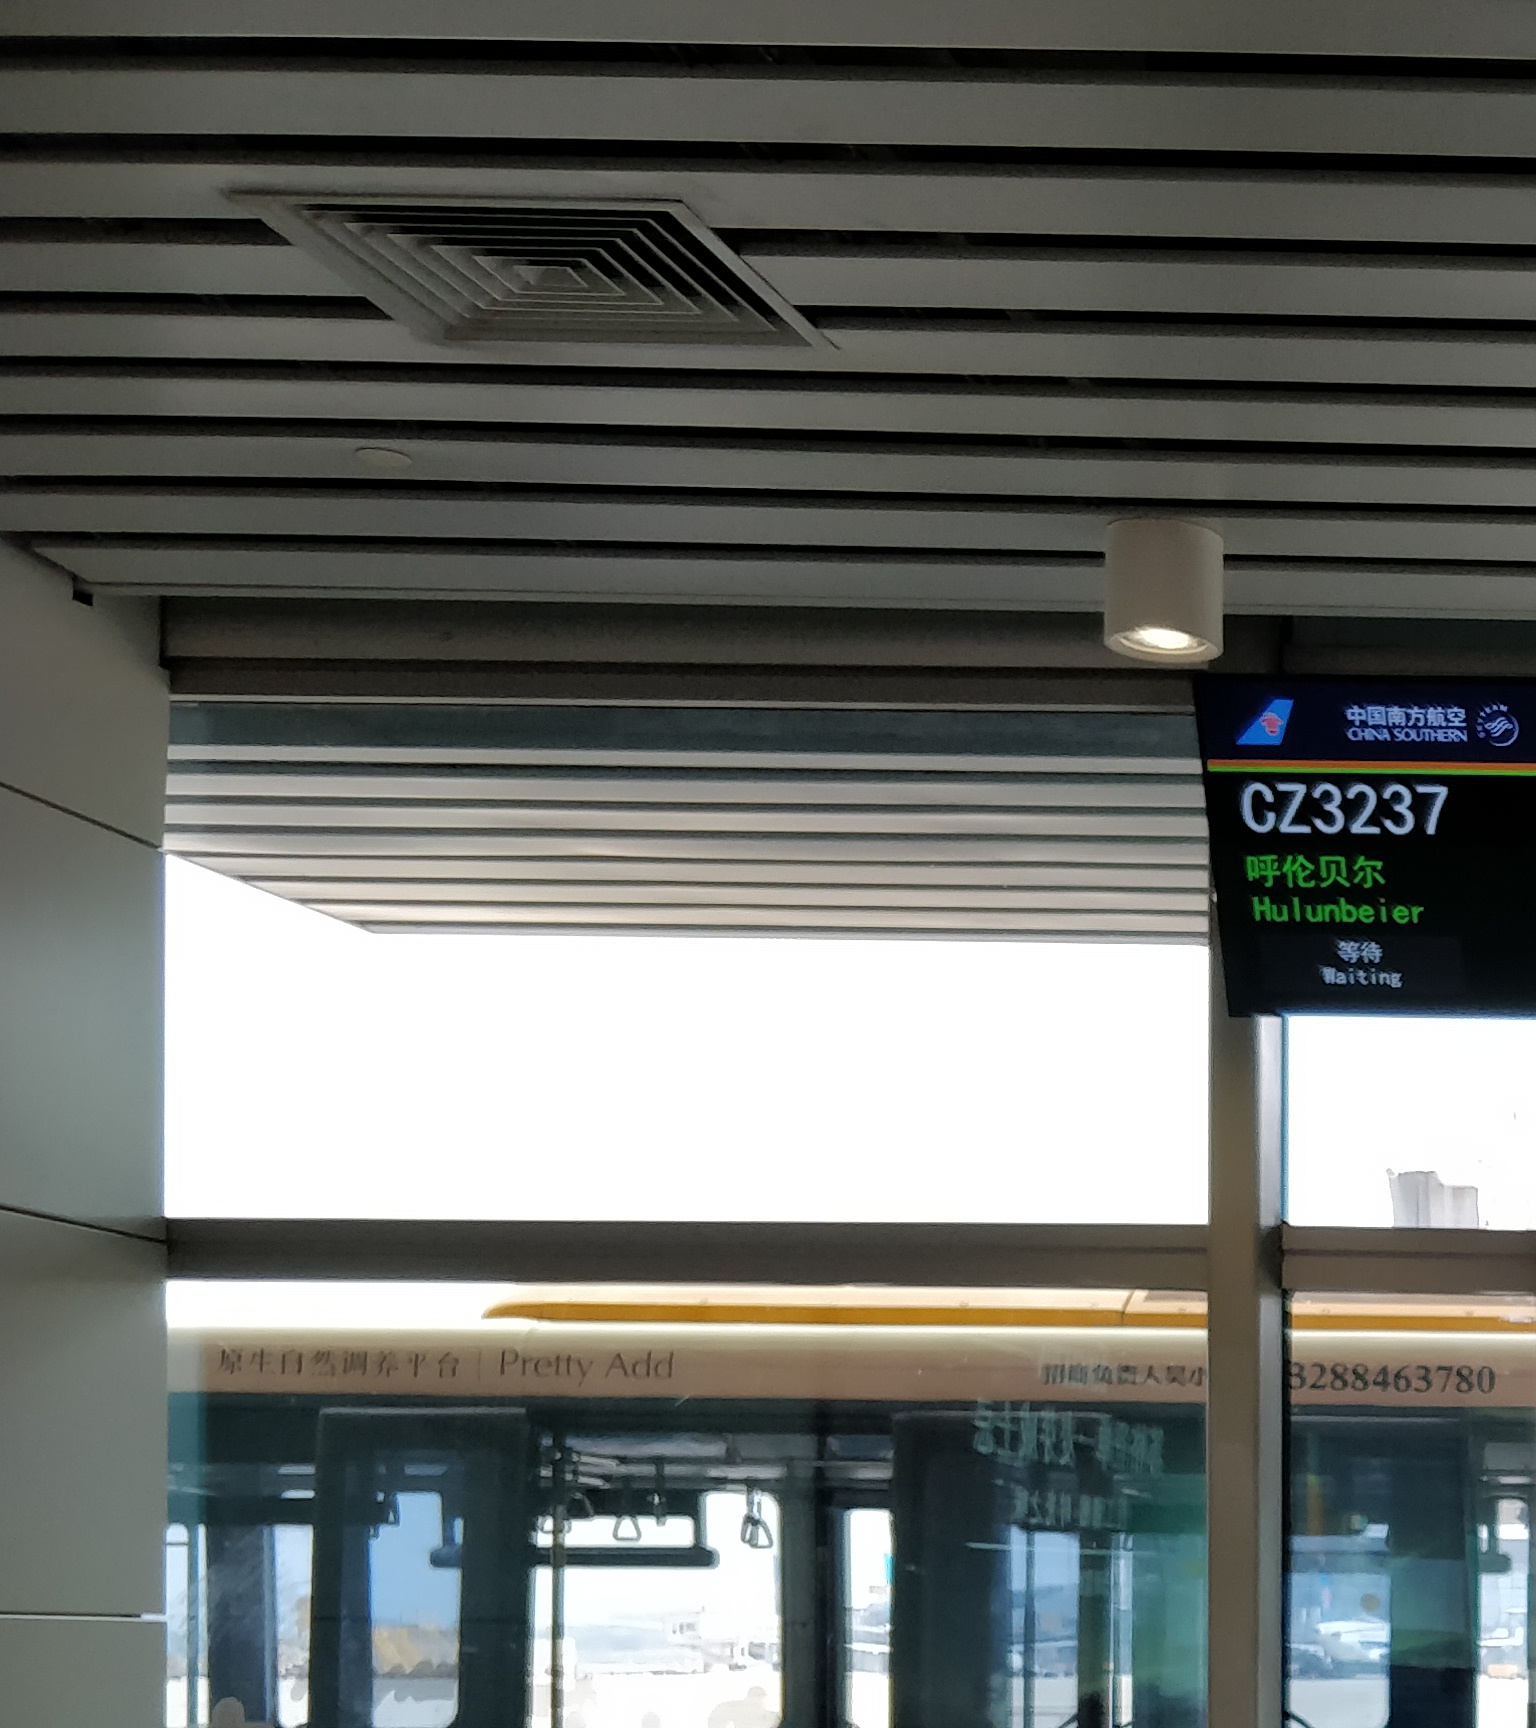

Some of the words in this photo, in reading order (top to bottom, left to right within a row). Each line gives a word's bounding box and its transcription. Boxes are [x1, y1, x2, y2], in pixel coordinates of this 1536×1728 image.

[1345, 706, 1467, 728] 中国南方航空
[1345, 728, 1392, 742] CHINA
[1393, 728, 1468, 743] SOUTHERN
[1240, 782, 1449, 835] CZ3237
[1246, 855, 1386, 888] 呼伦贝尔
[1253, 897, 1424, 924] Hulunbeier
[1337, 940, 1383, 964] 等待
[1321, 966, 1402, 988] Waiting
[500, 1351, 593, 1385] Pretty
[605, 1351, 675, 1379] Add
